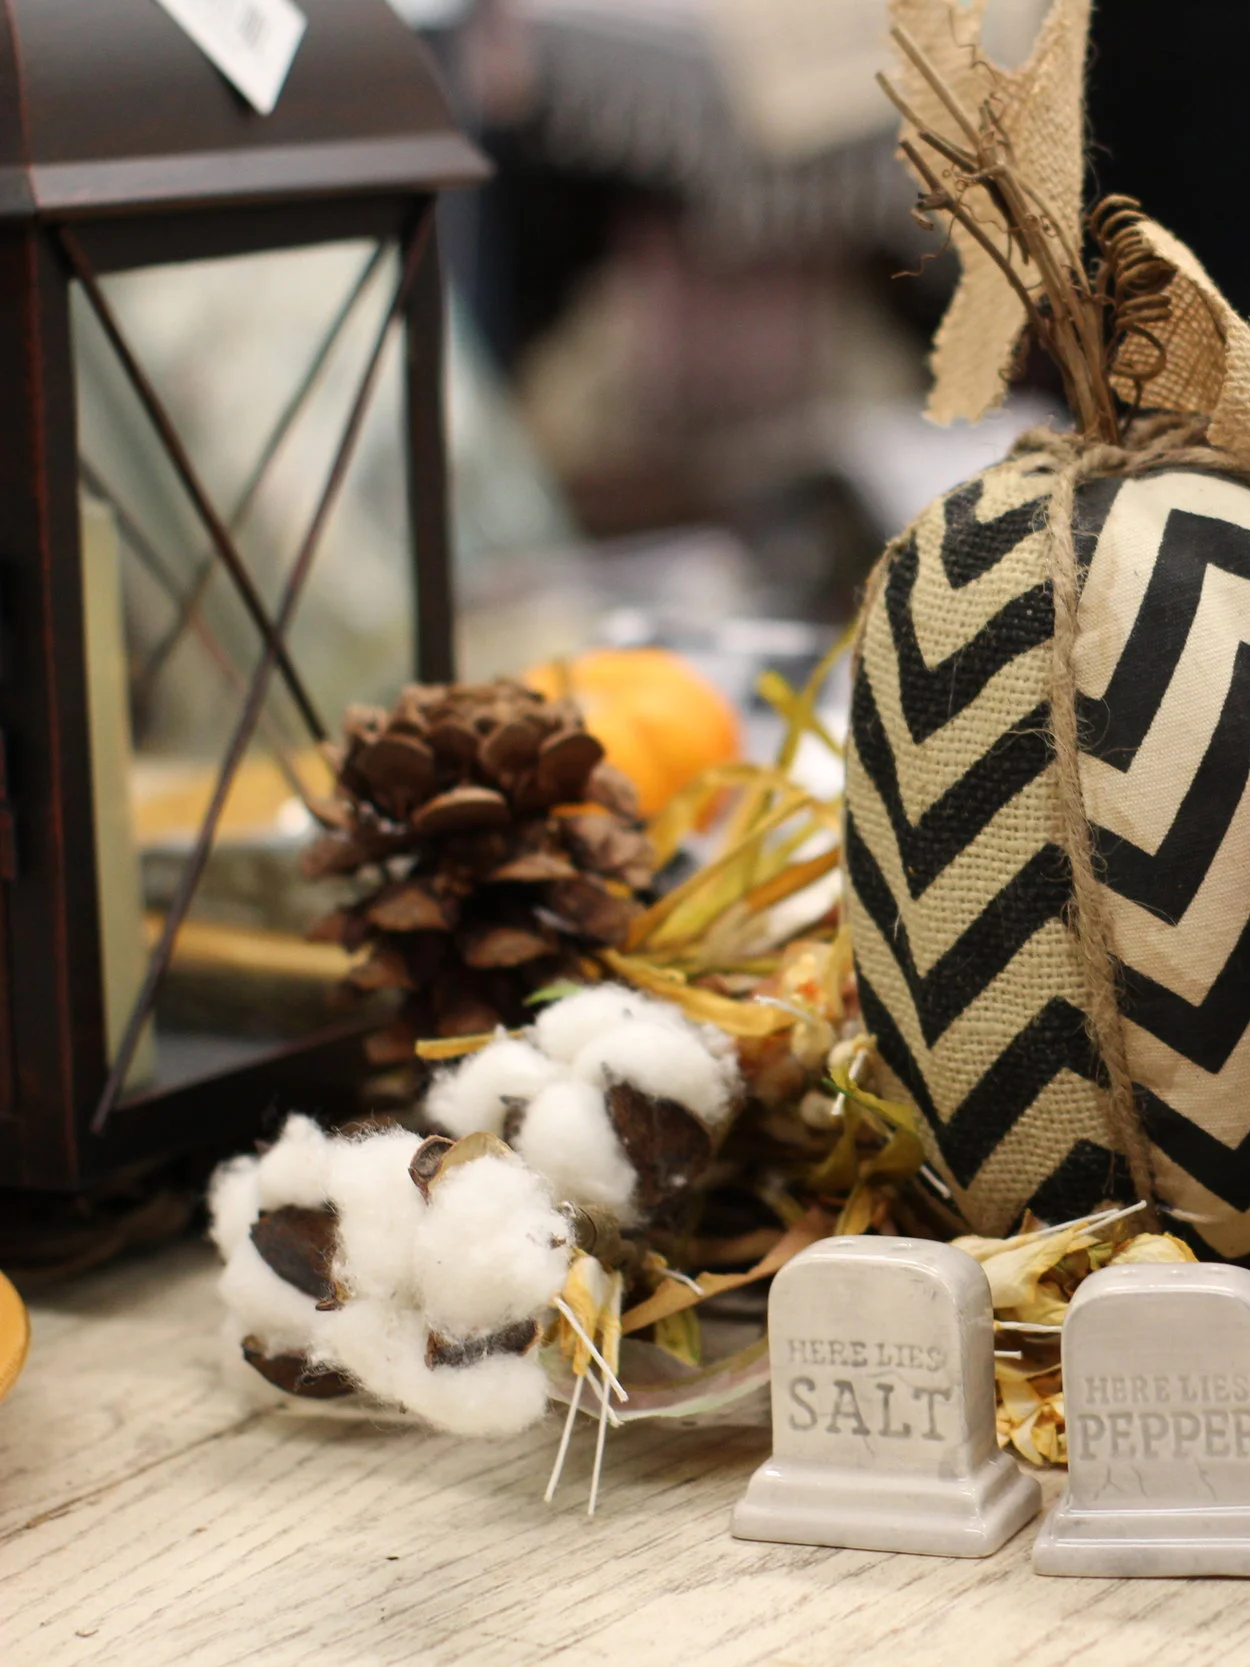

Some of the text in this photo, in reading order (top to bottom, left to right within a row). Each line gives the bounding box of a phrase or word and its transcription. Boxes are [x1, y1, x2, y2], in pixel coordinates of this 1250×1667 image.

[786, 1338, 944, 1372] HERE LIES
[1085, 1372, 1250, 1405] HERE LIES
[788, 1375, 953, 1441] SALT
